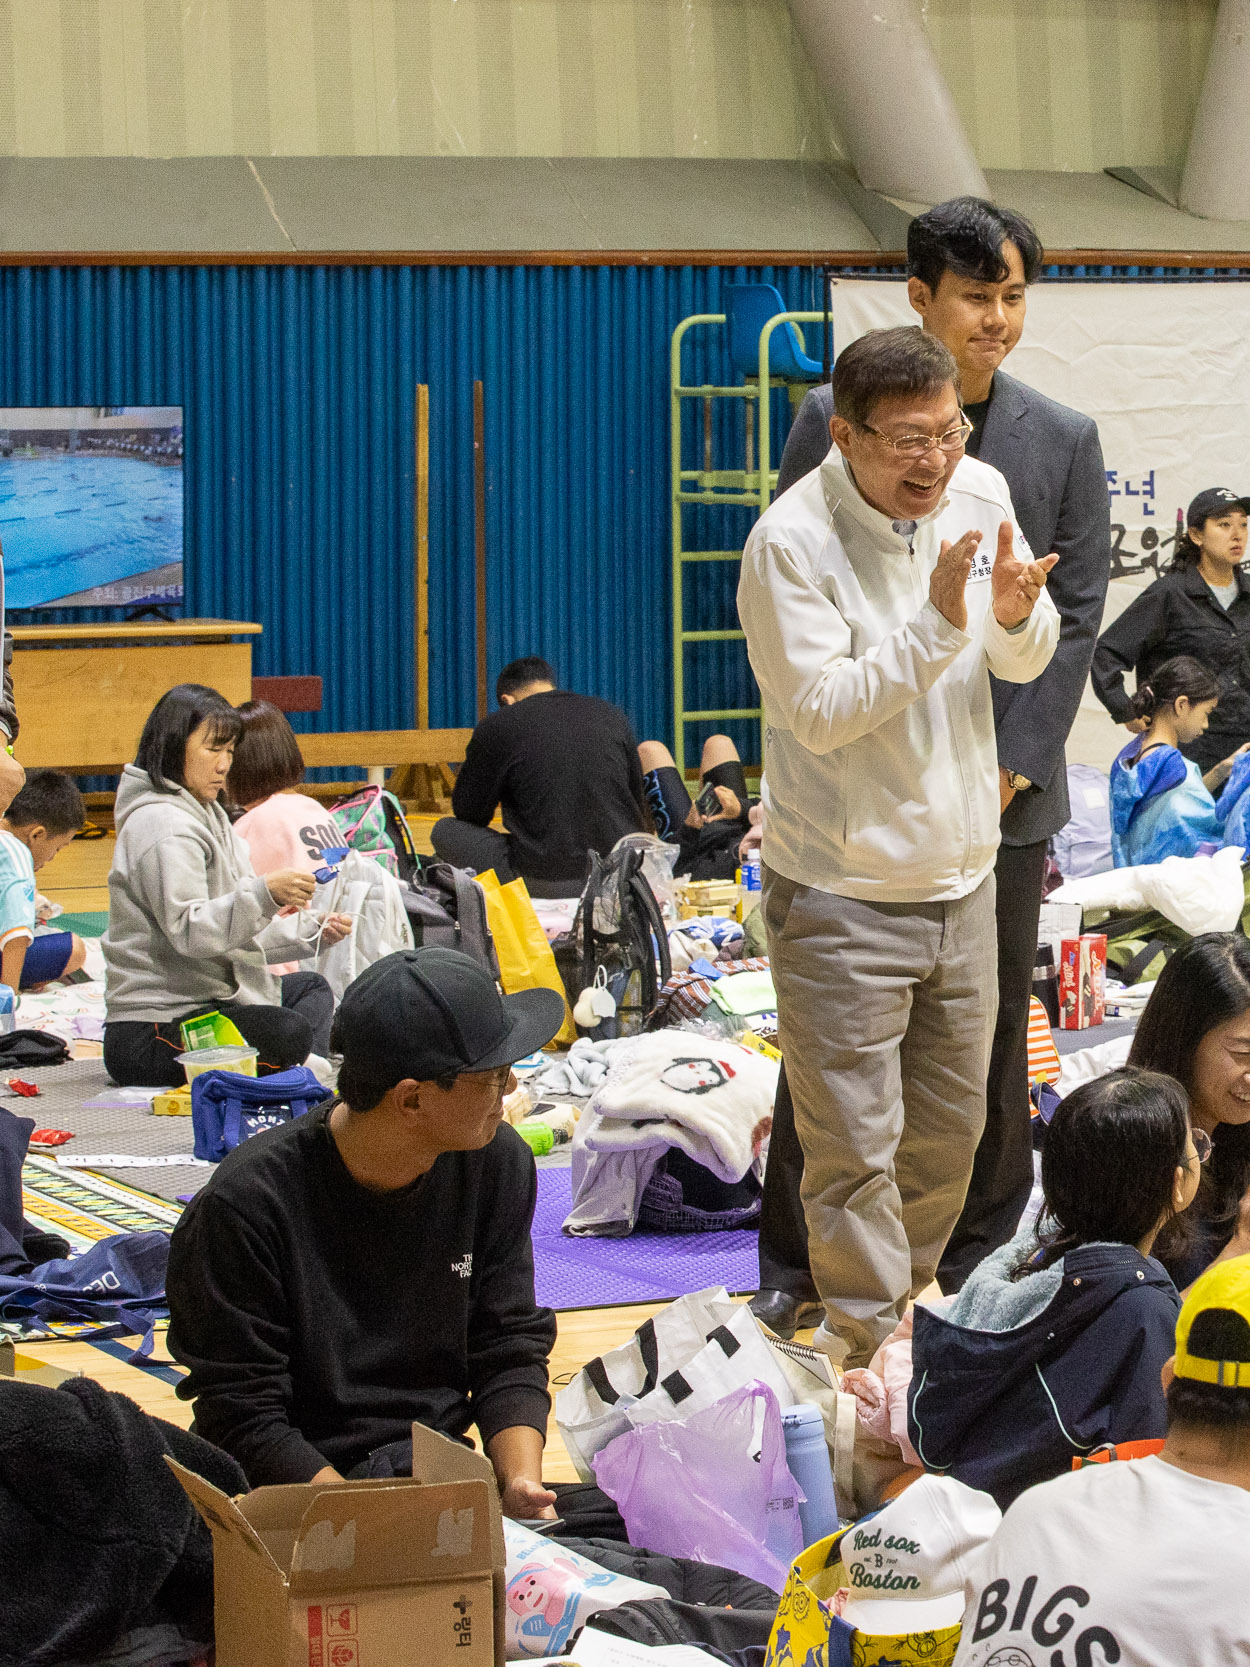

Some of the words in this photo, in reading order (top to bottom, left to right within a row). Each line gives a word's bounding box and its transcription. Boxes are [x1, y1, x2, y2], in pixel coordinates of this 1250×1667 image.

[853, 1528, 882, 1551] Red
[884, 1535, 920, 1554] sox
[874, 1554, 883, 1568] B
[850, 1562, 921, 1590] Boston
[453, 1616, 472, 1647] 링티
